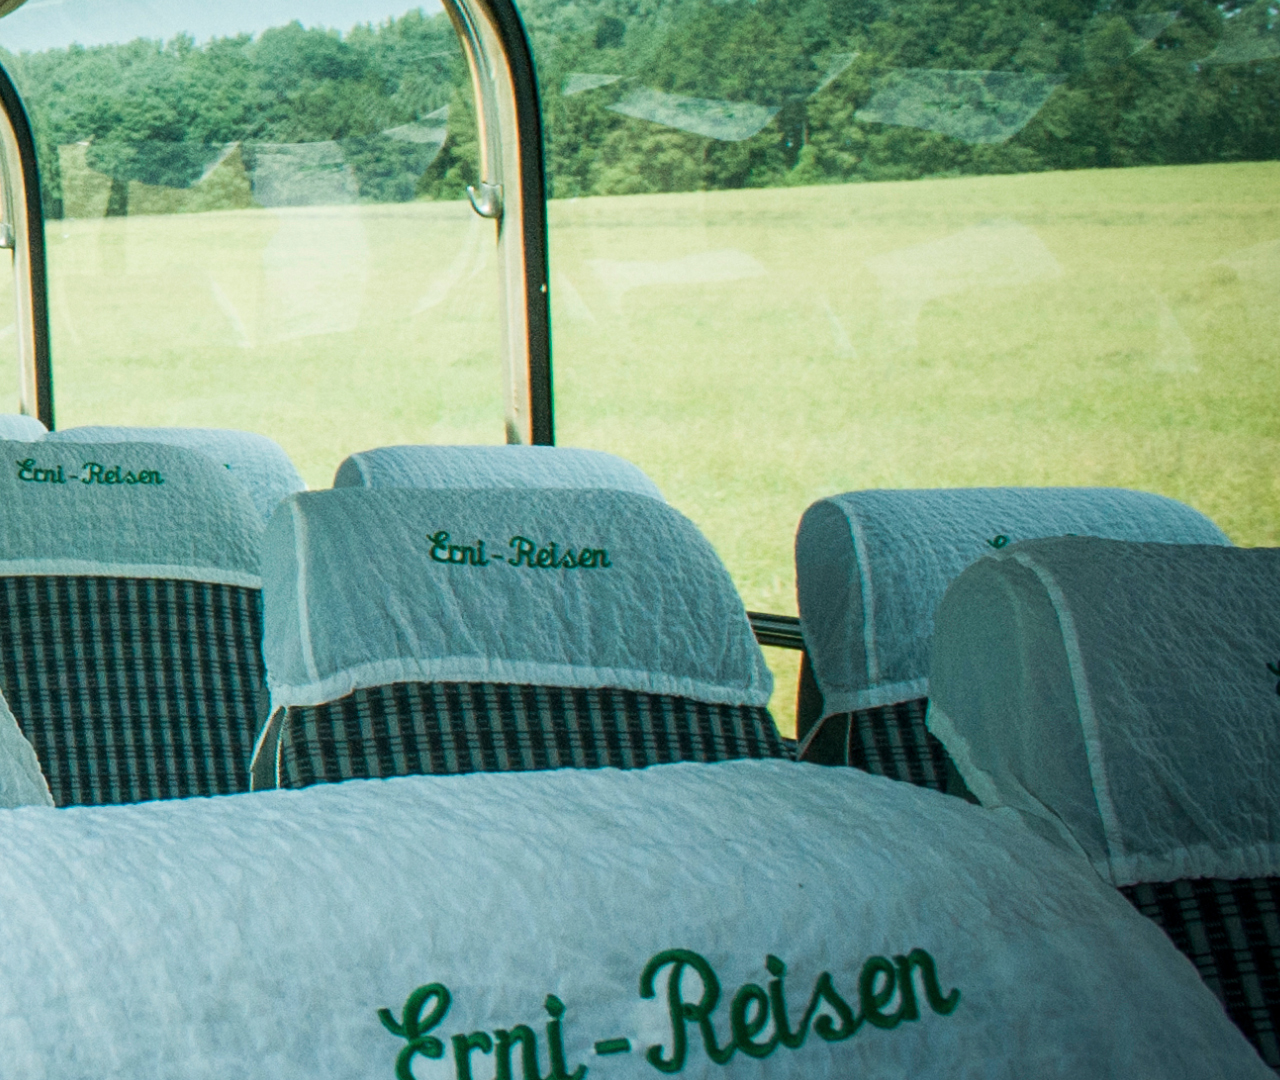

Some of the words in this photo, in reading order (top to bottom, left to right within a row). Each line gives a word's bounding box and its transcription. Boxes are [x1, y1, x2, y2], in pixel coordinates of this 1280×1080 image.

[17, 458, 164, 485] Erni-Reisen
[429, 531, 611, 569] Erni-Reisen
[377, 947, 961, 1080] Erni-Reisen
